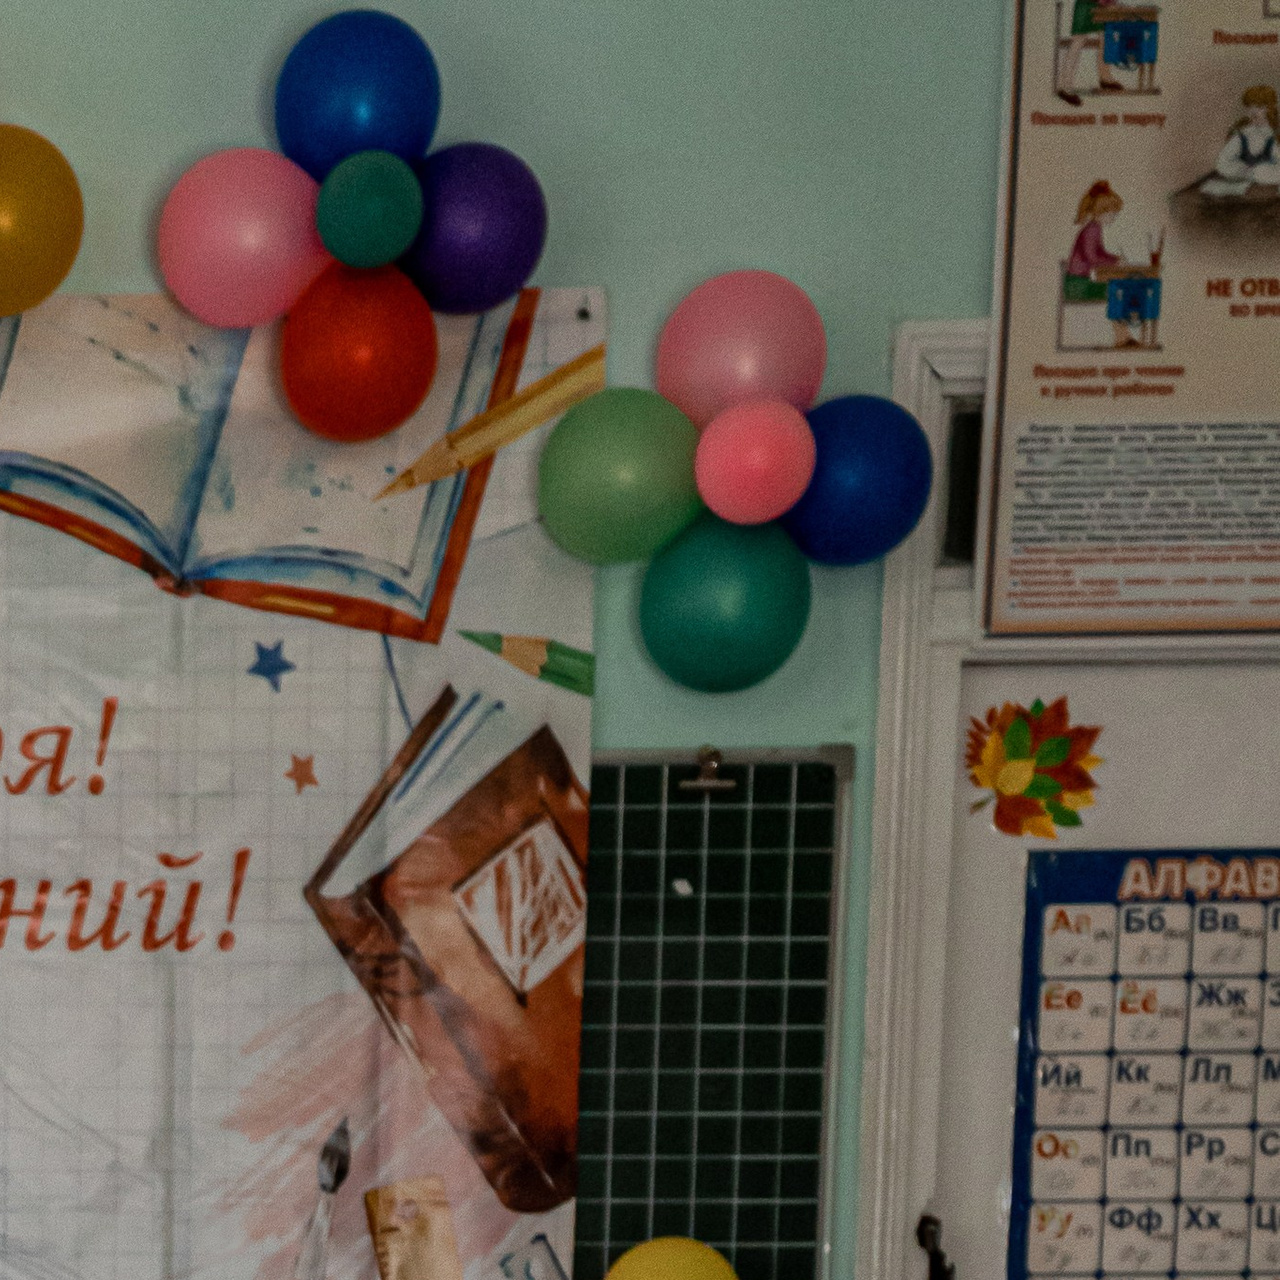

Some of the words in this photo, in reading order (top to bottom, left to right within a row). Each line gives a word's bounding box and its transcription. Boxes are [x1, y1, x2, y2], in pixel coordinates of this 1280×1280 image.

[1124, 906, 1166, 934] Бб
[1198, 906, 1240, 934] Вв
[1196, 982, 1249, 1008] Жж
[1116, 1059, 1150, 1083] Кк
[1190, 1058, 1232, 1084] Лл
[1035, 1132, 1079, 1160] Оо
[1111, 1132, 1152, 1158] Пп
[1185, 1132, 1226, 1161] Рр
[1109, 1206, 1163, 1235] Фф
[1184, 1205, 1222, 1231] Хх
